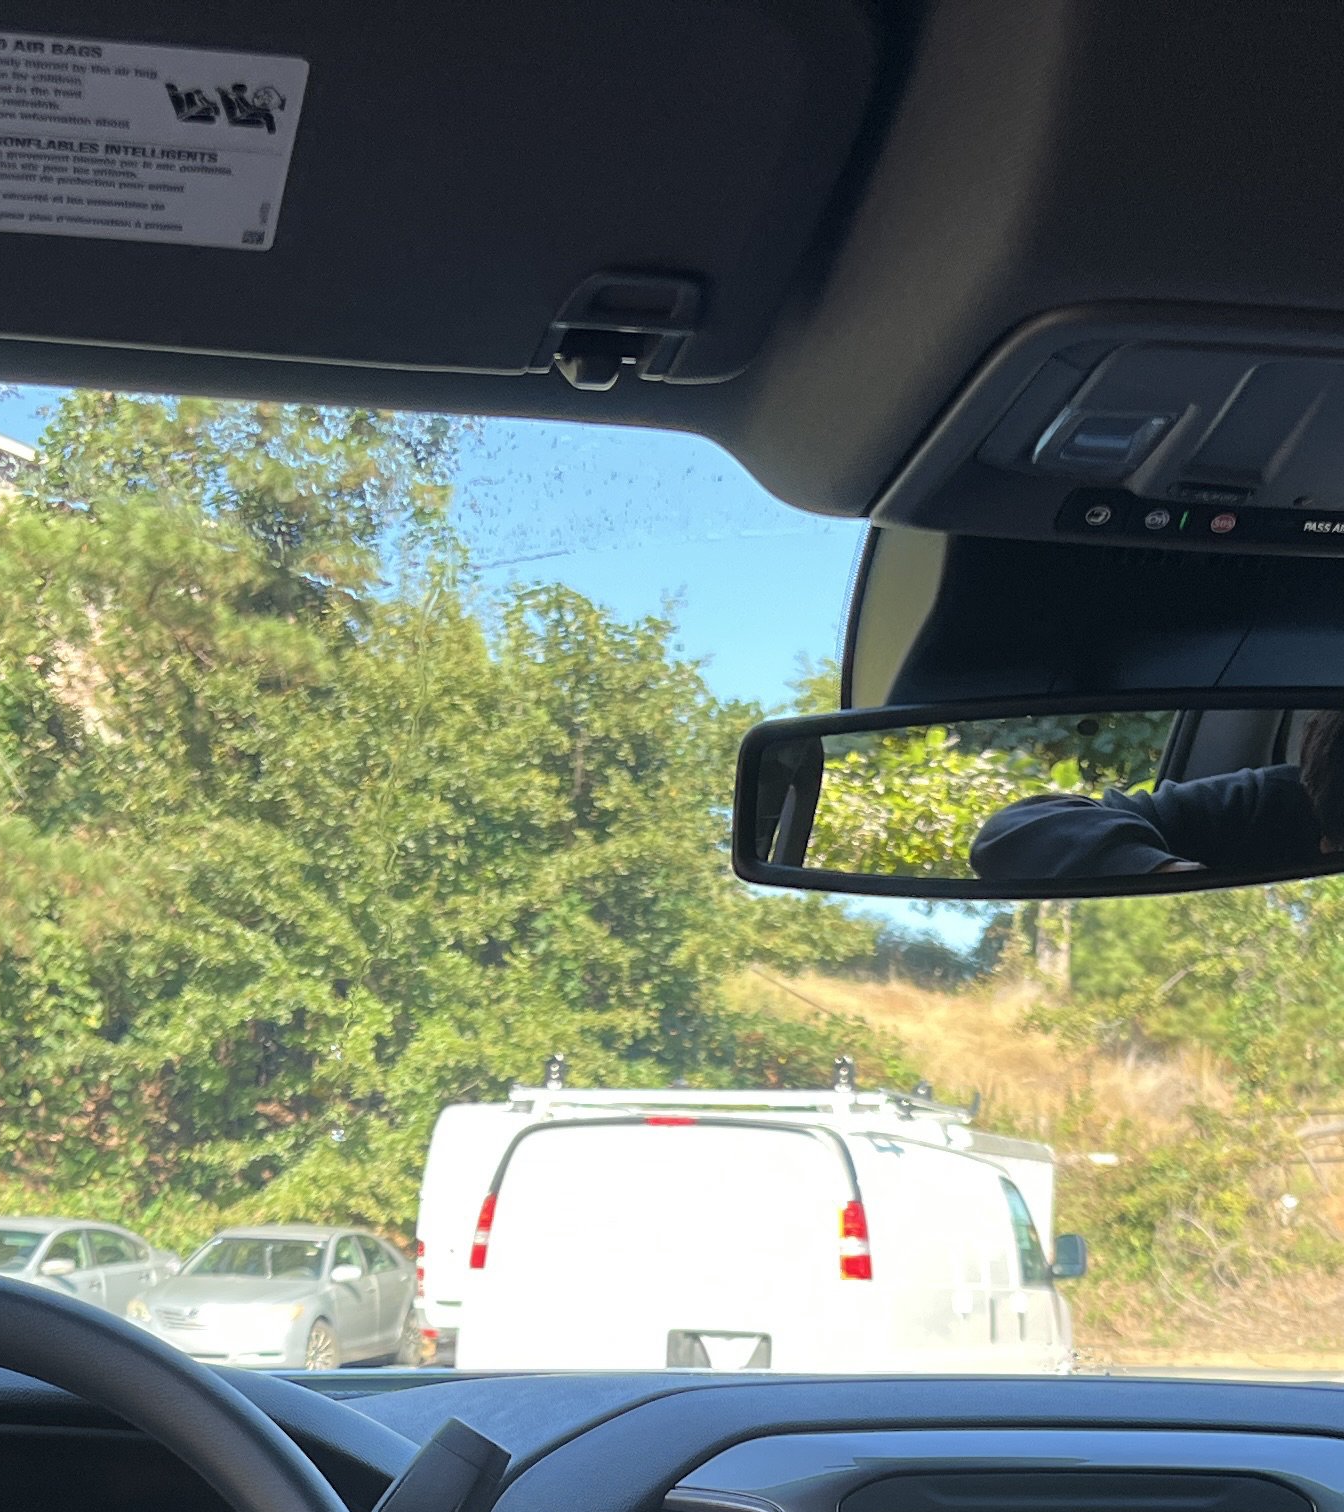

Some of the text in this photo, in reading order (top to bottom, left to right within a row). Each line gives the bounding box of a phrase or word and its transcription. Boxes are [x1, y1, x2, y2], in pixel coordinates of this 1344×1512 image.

[14, 40, 46, 54] AIR
[51, 43, 103, 58] BAGS
[104, 144, 218, 164] INTELLIGENTS
[1304, 521, 1331, 534] PASS
